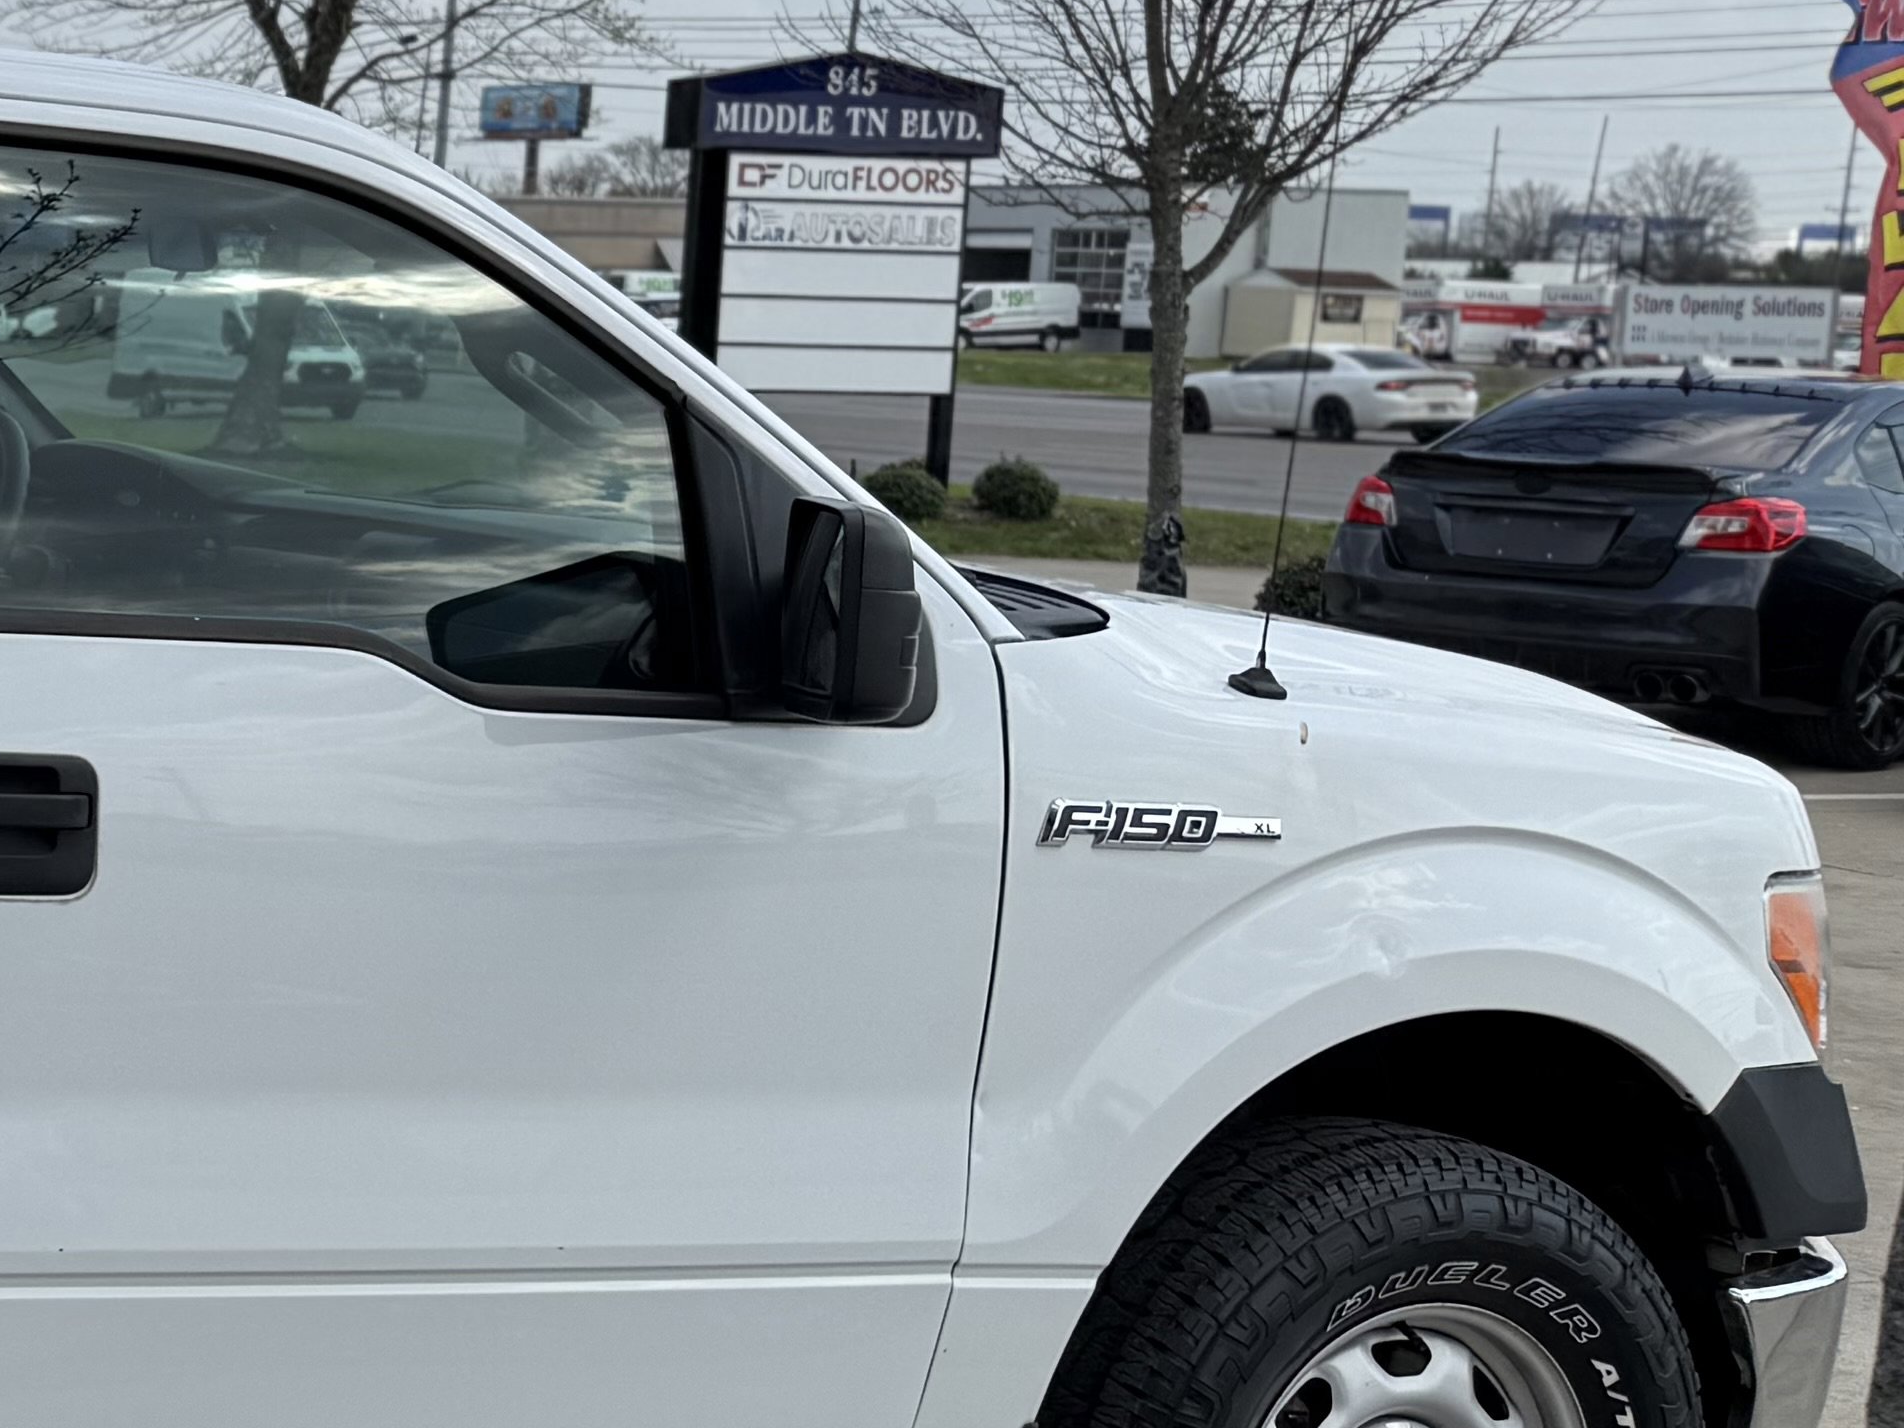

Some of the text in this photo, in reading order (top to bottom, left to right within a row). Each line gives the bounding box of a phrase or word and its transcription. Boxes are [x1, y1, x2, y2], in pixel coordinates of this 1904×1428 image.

[827, 66, 879, 97] 845
[714, 102, 984, 141] MIDDLE TN BLVD.
[787, 164, 955, 194] DuraFLOORS
[1633, 292, 1826, 320] Store Opening Solutions
[1254, 821, 1276, 835] XL
[1327, 1260, 1603, 1346] DUELER
